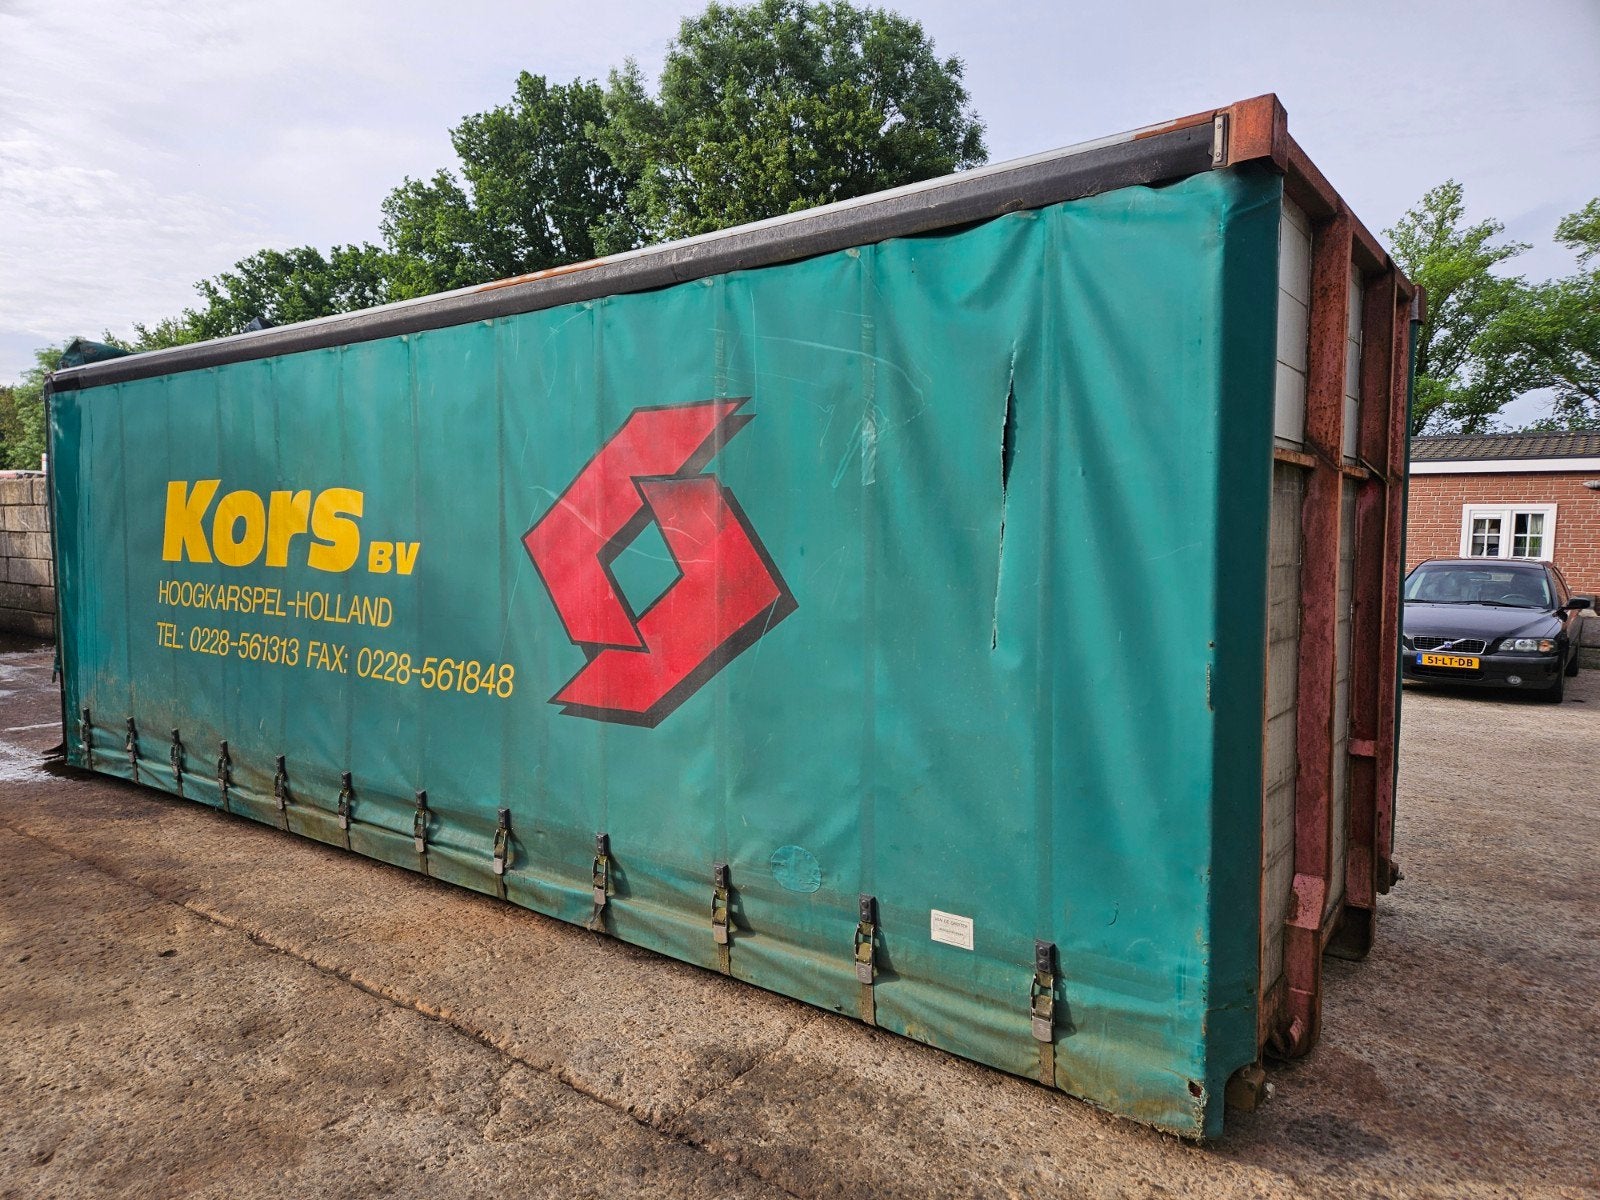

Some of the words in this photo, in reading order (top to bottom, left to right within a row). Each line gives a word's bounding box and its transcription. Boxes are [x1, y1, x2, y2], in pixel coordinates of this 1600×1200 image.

[162, 479, 364, 572] Kors
[368, 541, 420, 575] BV
[159, 580, 392, 628] HOOGKARSPEL-HOLLAND
[156, 621, 184, 649] TEL:
[190, 626, 299, 666] 0228-561313
[306, 641, 349, 674] FAX:
[357, 647, 514, 698] 0228-561848
[1427, 655, 1473, 667] 51-LT-DB
